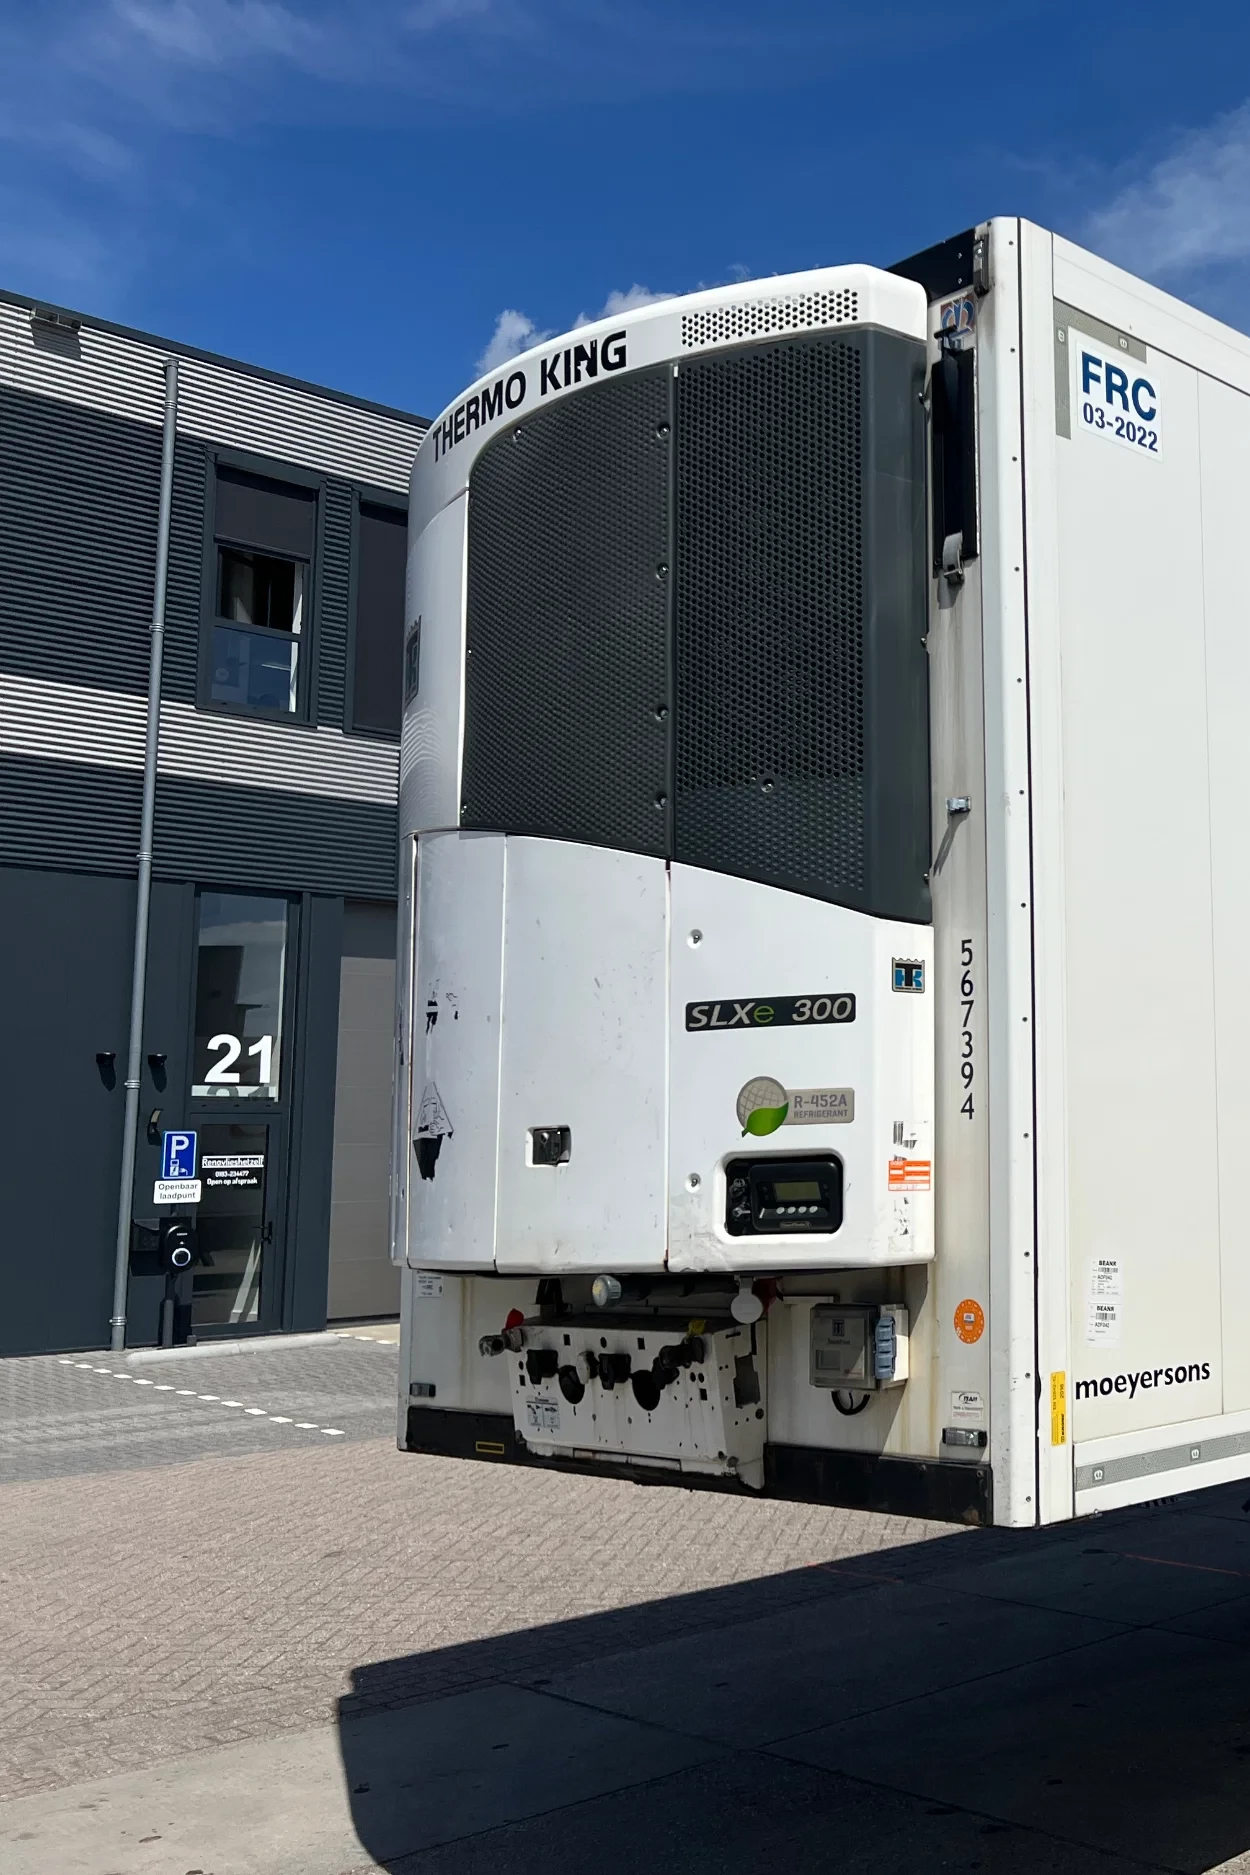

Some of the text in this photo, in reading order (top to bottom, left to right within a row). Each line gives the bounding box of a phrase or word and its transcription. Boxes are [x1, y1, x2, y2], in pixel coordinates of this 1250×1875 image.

[432, 330, 627, 463] THERMO KING
[1081, 350, 1157, 422] FRC
[1082, 402, 1158, 453] 03-2022
[688, 997, 853, 1028] SLXe 300
[960, 939, 975, 1120] 567394
[204, 1033, 273, 1084] 21
[793, 1109, 848, 1119] REFRIGERANT
[794, 1094, 848, 1109] R-452A
[158, 1183, 198, 1191] Openbaar
[159, 1191, 196, 1200] laadpunt
[206, 1178, 223, 1186] Open
[231, 1177, 258, 1186] afspraak
[1075, 1362, 1211, 1400] moeyersons
